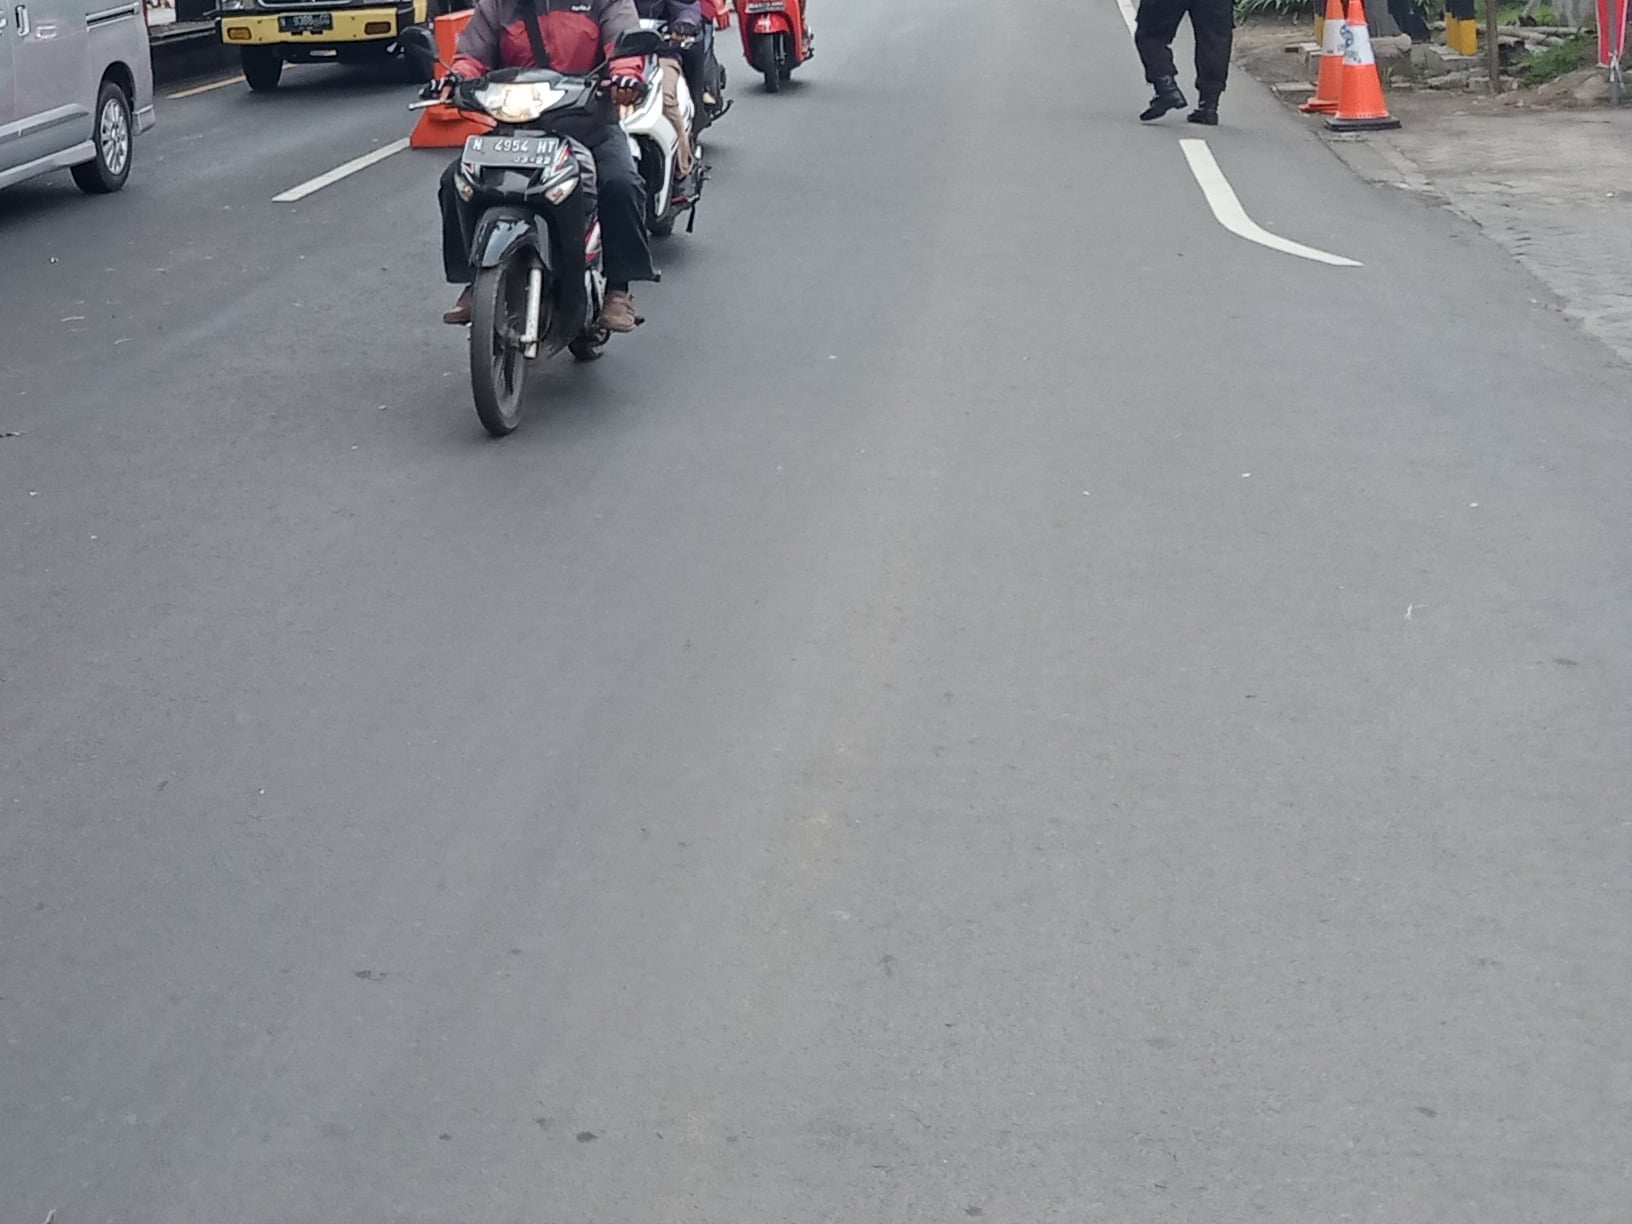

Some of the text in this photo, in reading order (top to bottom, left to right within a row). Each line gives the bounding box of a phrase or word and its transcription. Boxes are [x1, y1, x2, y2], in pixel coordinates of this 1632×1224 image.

[472, 138, 556, 153] N 4954 HT
